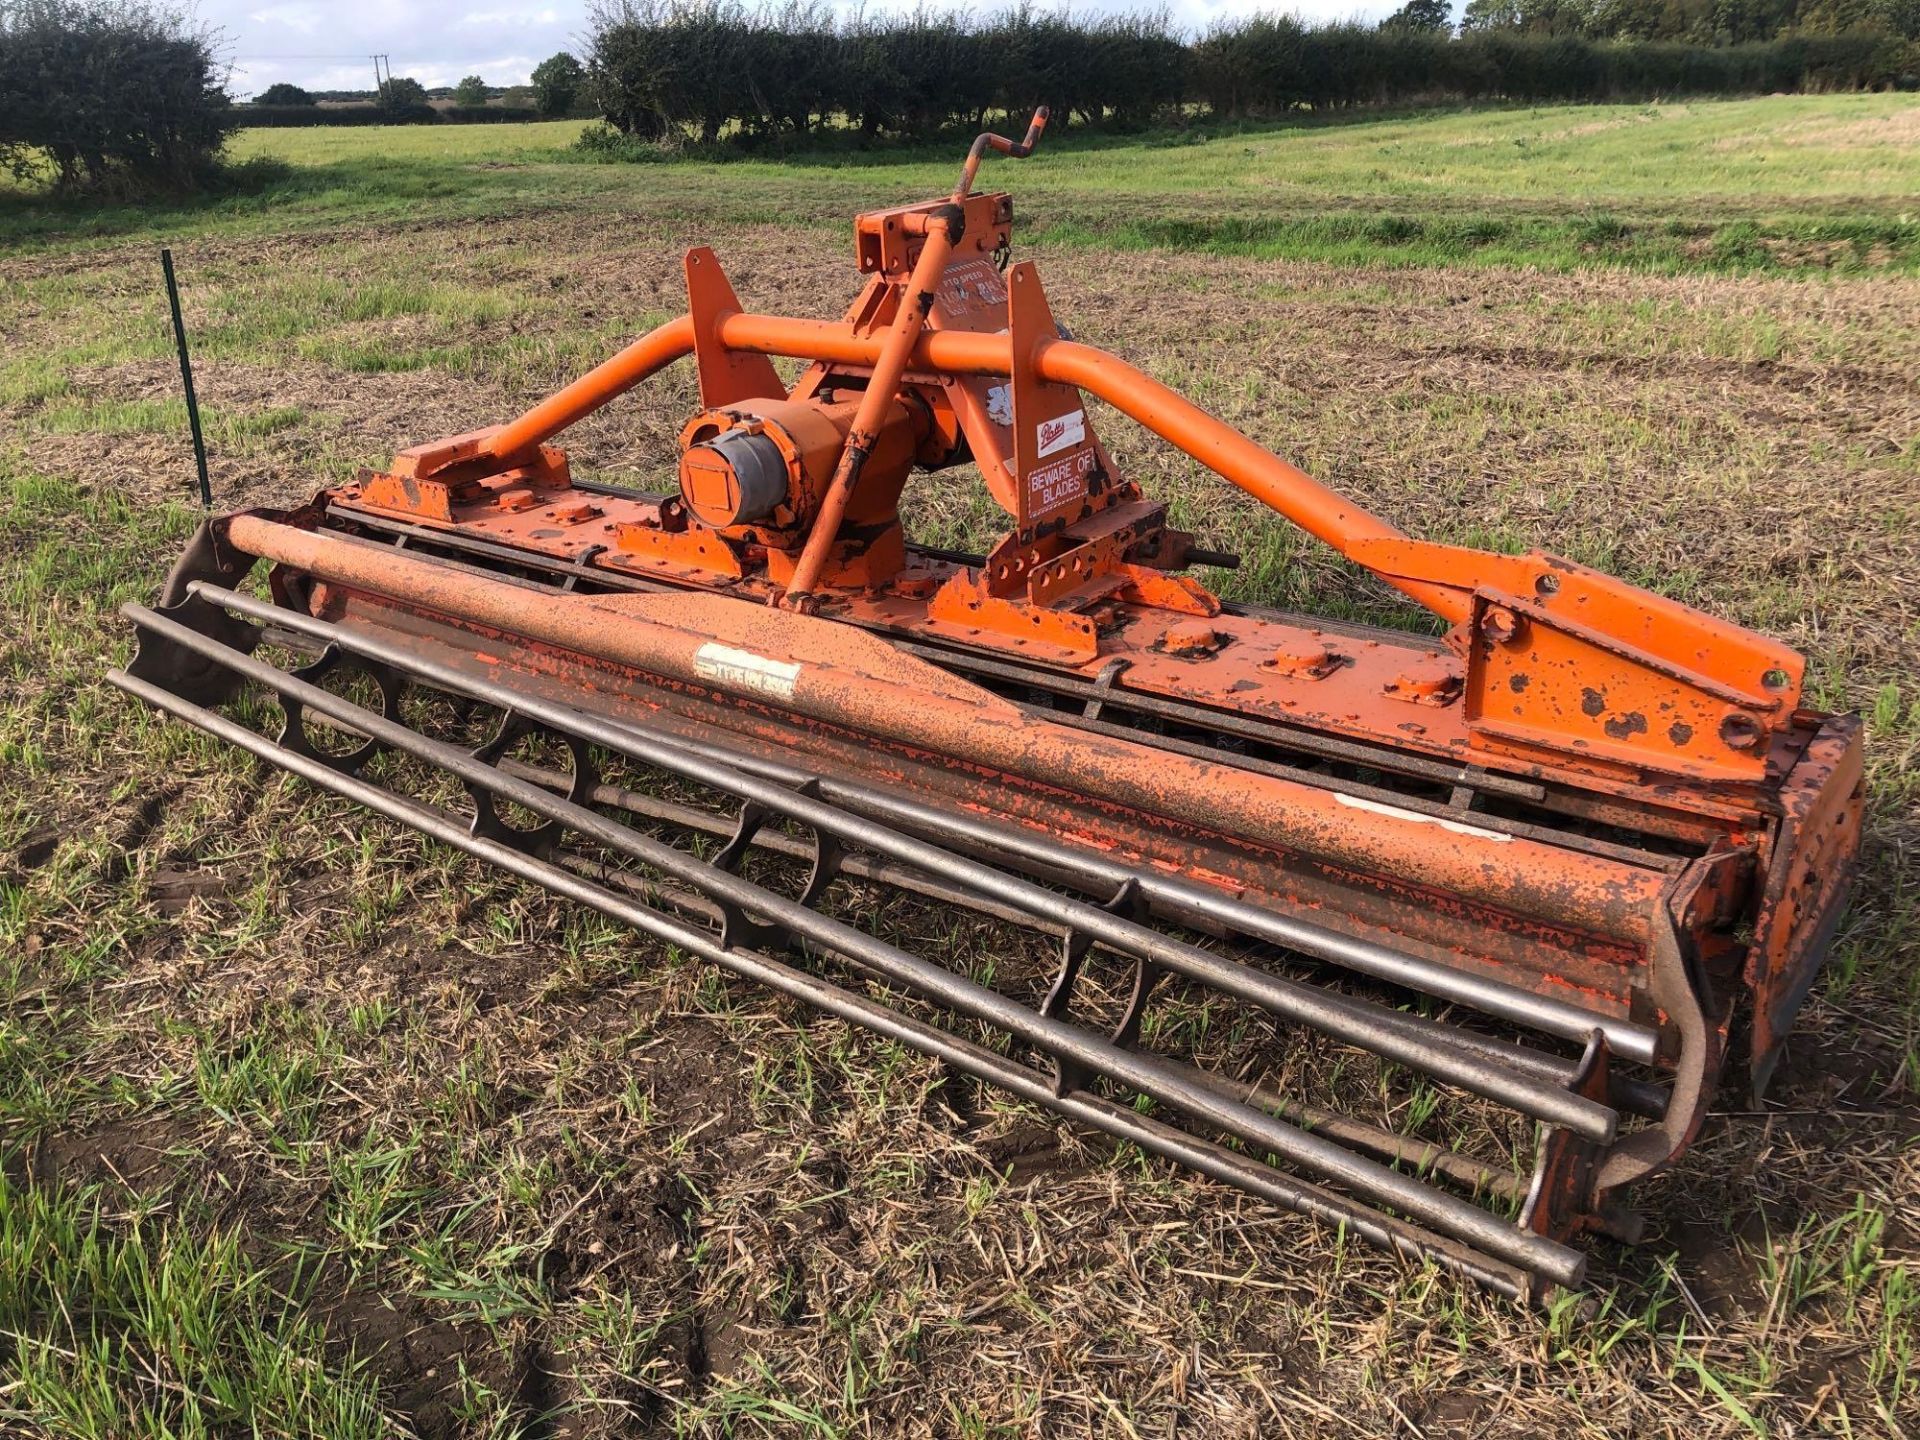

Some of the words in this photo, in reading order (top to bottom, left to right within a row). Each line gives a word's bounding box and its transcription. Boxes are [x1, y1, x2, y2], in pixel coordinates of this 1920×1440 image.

[943, 278, 960, 287] PTO
[960, 271, 983, 283] SPEED
[1031, 462, 1072, 492] BEWARE
[1077, 454, 1091, 473] OF
[1043, 475, 1081, 504] BLADES
